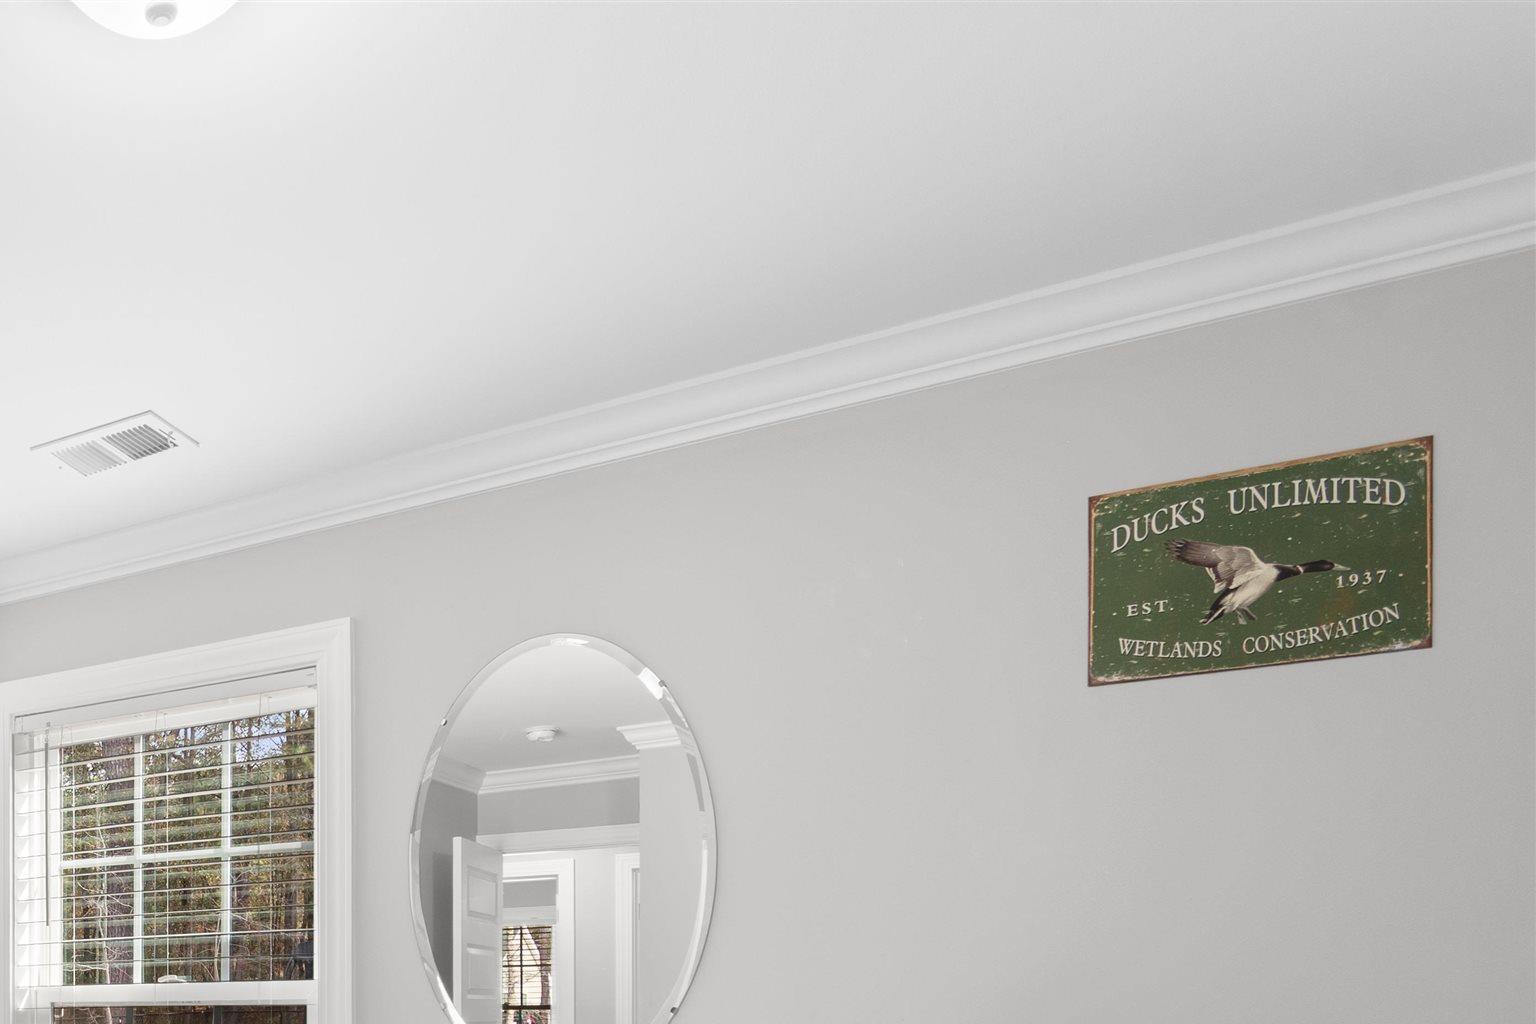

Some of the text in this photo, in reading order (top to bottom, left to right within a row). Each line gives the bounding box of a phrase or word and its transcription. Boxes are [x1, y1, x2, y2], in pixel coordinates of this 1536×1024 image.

[1109, 477, 1406, 553] DUCKS UNLIMITED
[1336, 569, 1387, 589] 1937
[1118, 603, 1401, 659] WETLANDS CONSERVATION
